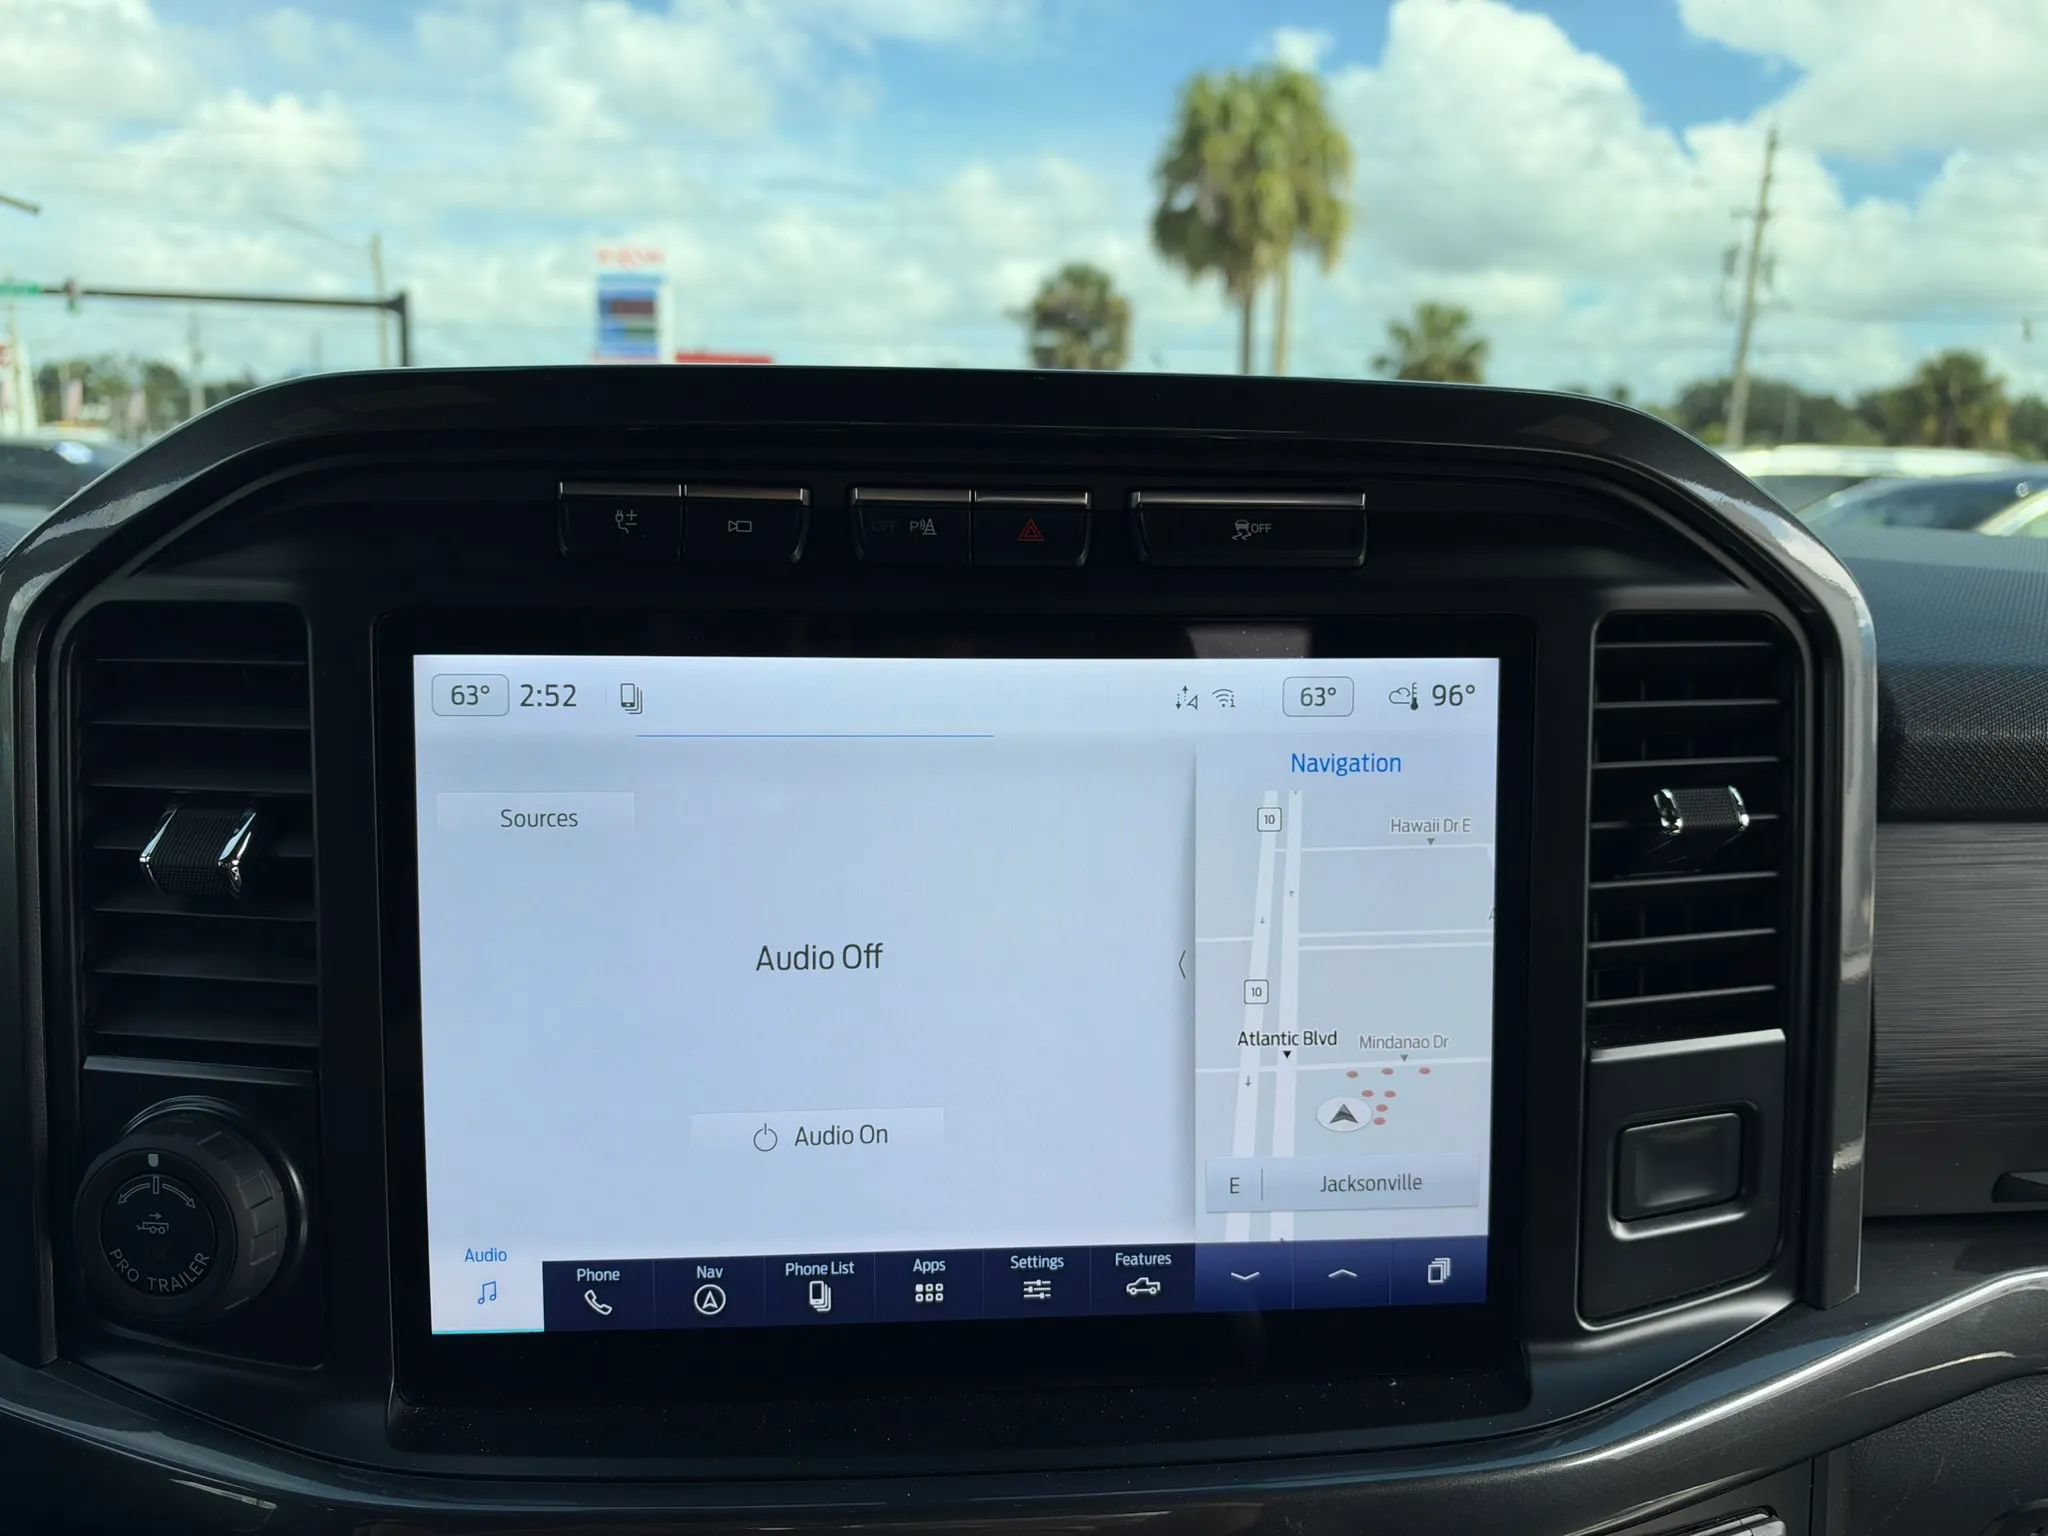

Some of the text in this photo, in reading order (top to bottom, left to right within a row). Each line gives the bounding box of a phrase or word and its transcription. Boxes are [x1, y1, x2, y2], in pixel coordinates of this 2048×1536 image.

[1250, 522, 1272, 534] OFF
[452, 684, 489, 706] 63°
[520, 683, 577, 707] 2:52
[1300, 686, 1337, 707] 63°
[1432, 684, 1476, 707] 96°
[1291, 752, 1401, 777] Navigation
[500, 808, 579, 828] Sources
[1264, 814, 1276, 826] 10
[1391, 818, 1471, 833] Hawaii Dr E
[756, 942, 884, 972] Audio Off
[1251, 986, 1263, 998] 10
[1237, 1030, 1337, 1047] Atlantic Blvd
[1359, 1034, 1449, 1049] Mindanao Dr
[794, 1124, 888, 1147] Audio On
[1229, 1176, 1240, 1195] E
[1320, 1173, 1422, 1193] Jacksonville
[464, 1247, 508, 1263] Audio
[1010, 1255, 1065, 1271] Settings
[1115, 1252, 1172, 1267] Features
[109, 1248, 210, 1293] PRO TRAILER
[576, 1267, 621, 1282] Phone
[696, 1265, 724, 1280] Nav
[785, 1261, 855, 1277] Phone List
[912, 1258, 946, 1275] Apps
